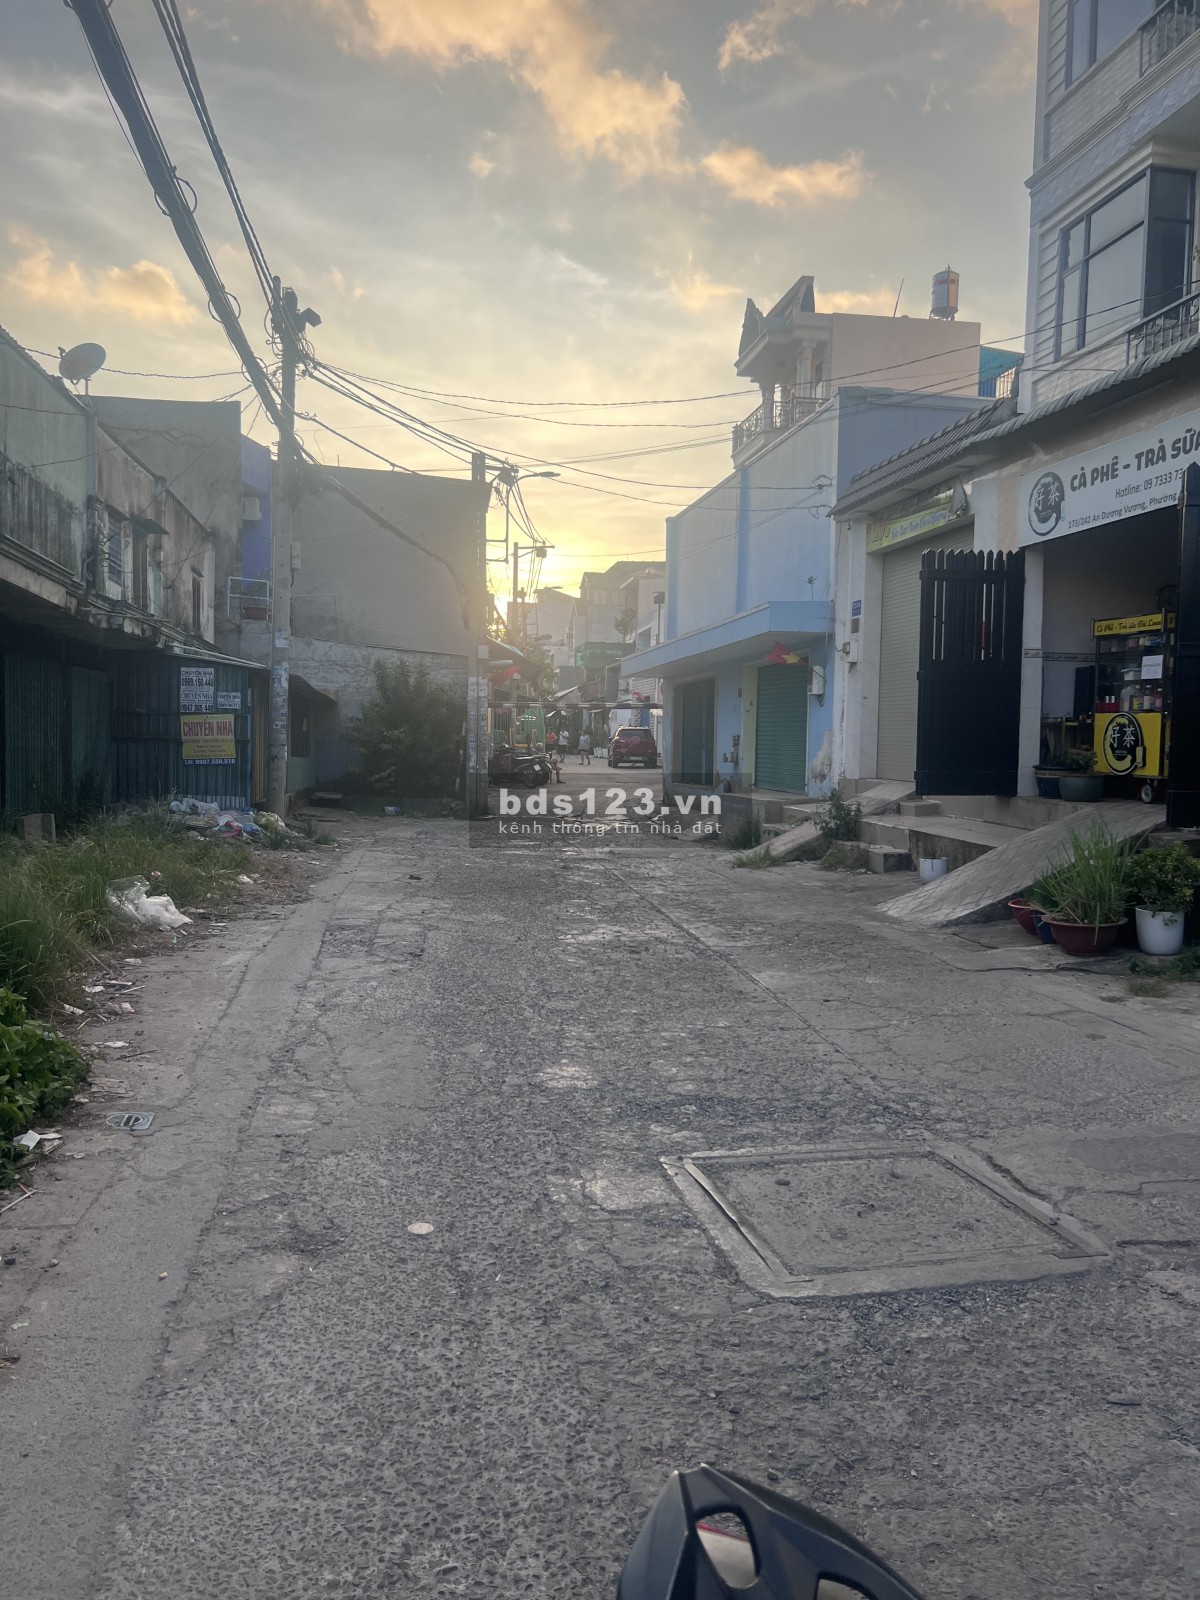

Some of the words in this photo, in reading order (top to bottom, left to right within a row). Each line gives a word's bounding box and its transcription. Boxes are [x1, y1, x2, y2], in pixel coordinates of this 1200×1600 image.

[1091, 456, 1119, 487] PHÊ
[1115, 483, 1142, 499] Hotline:
[1144, 478, 1153, 491] 09
[1154, 473, 1172, 488] 7333
